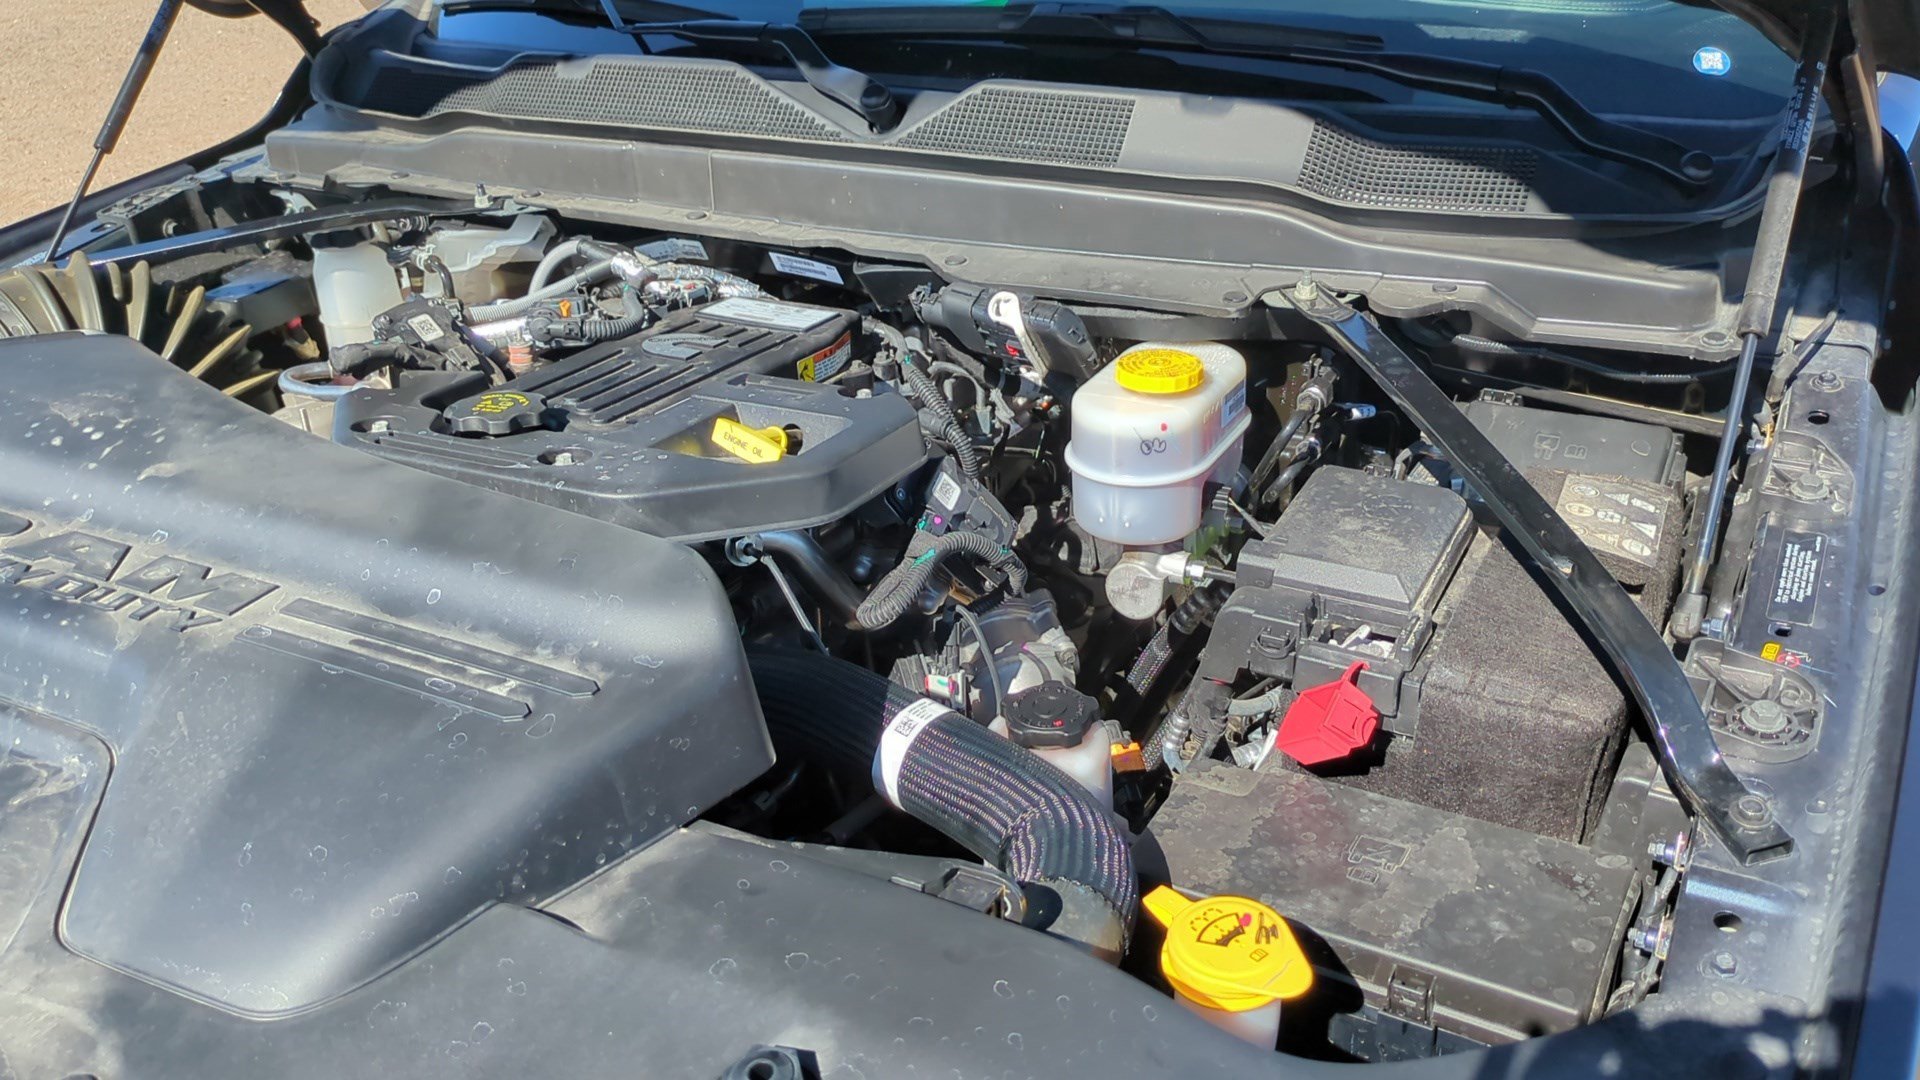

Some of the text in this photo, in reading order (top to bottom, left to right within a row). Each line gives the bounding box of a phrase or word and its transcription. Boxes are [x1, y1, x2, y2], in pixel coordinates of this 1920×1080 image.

[723, 432, 763, 458] ENGINE OIL
[0, 512, 280, 616] AM
[42, 574, 223, 632] DUTY
